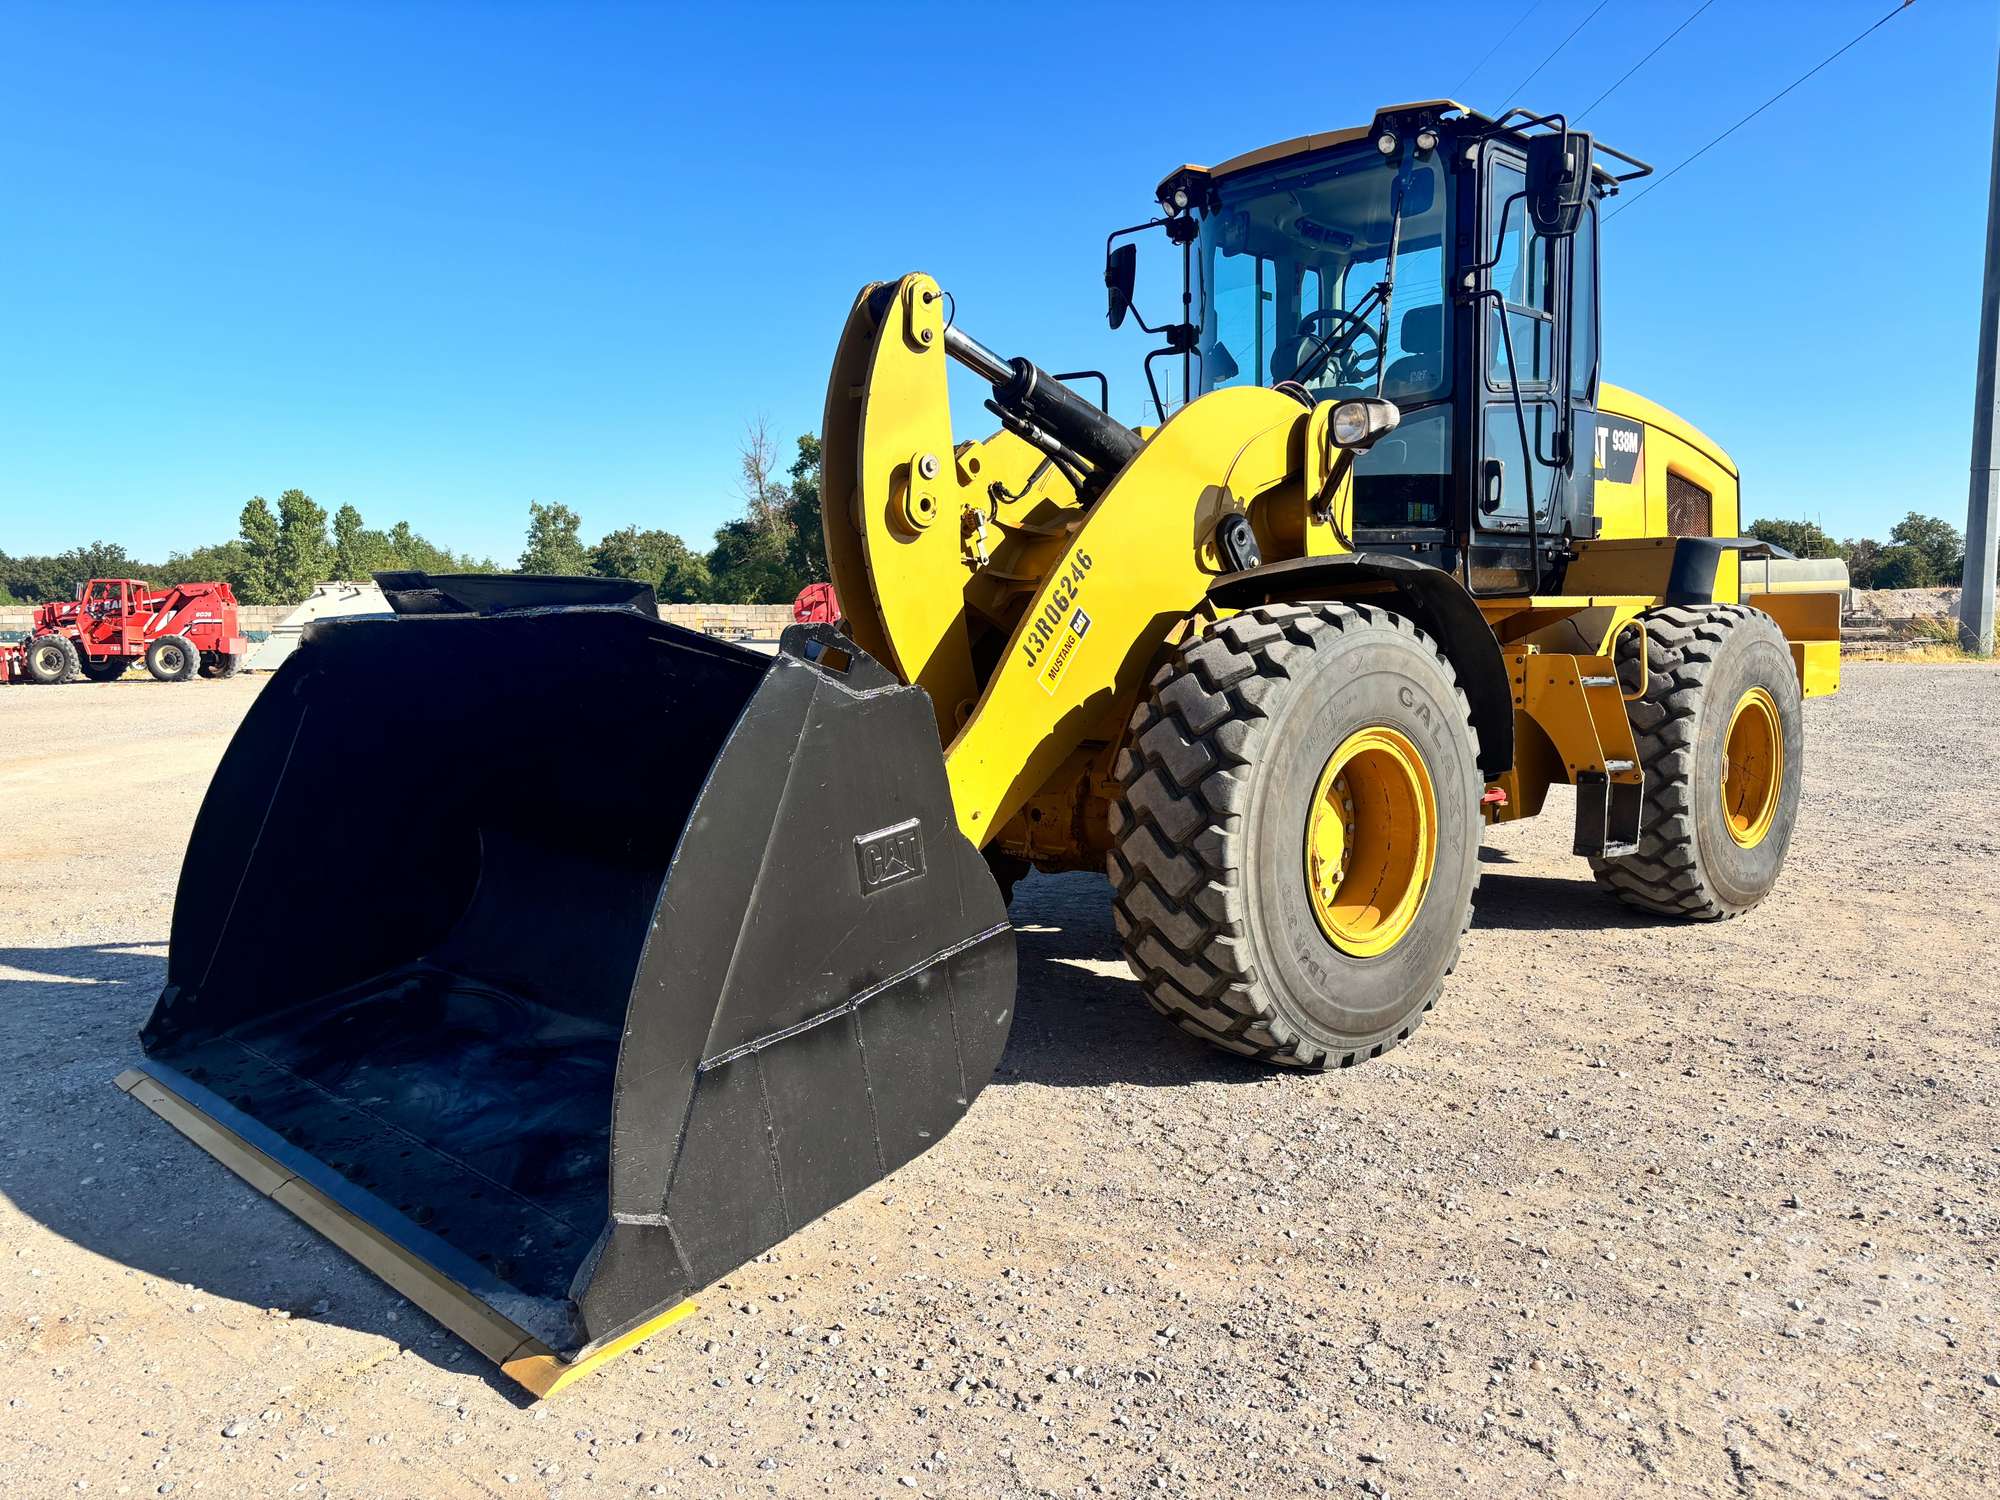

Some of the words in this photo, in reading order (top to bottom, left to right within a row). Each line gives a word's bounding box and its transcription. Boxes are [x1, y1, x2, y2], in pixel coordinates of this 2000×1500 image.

[1612, 429, 1638, 453] 938M
[1022, 549, 1092, 667] J3R06246
[1048, 635, 1076, 681] MUSTANG
[1072, 611, 1089, 635] CAT
[1399, 686, 1463, 856] GALAXY
[864, 831, 915, 884] CAT
